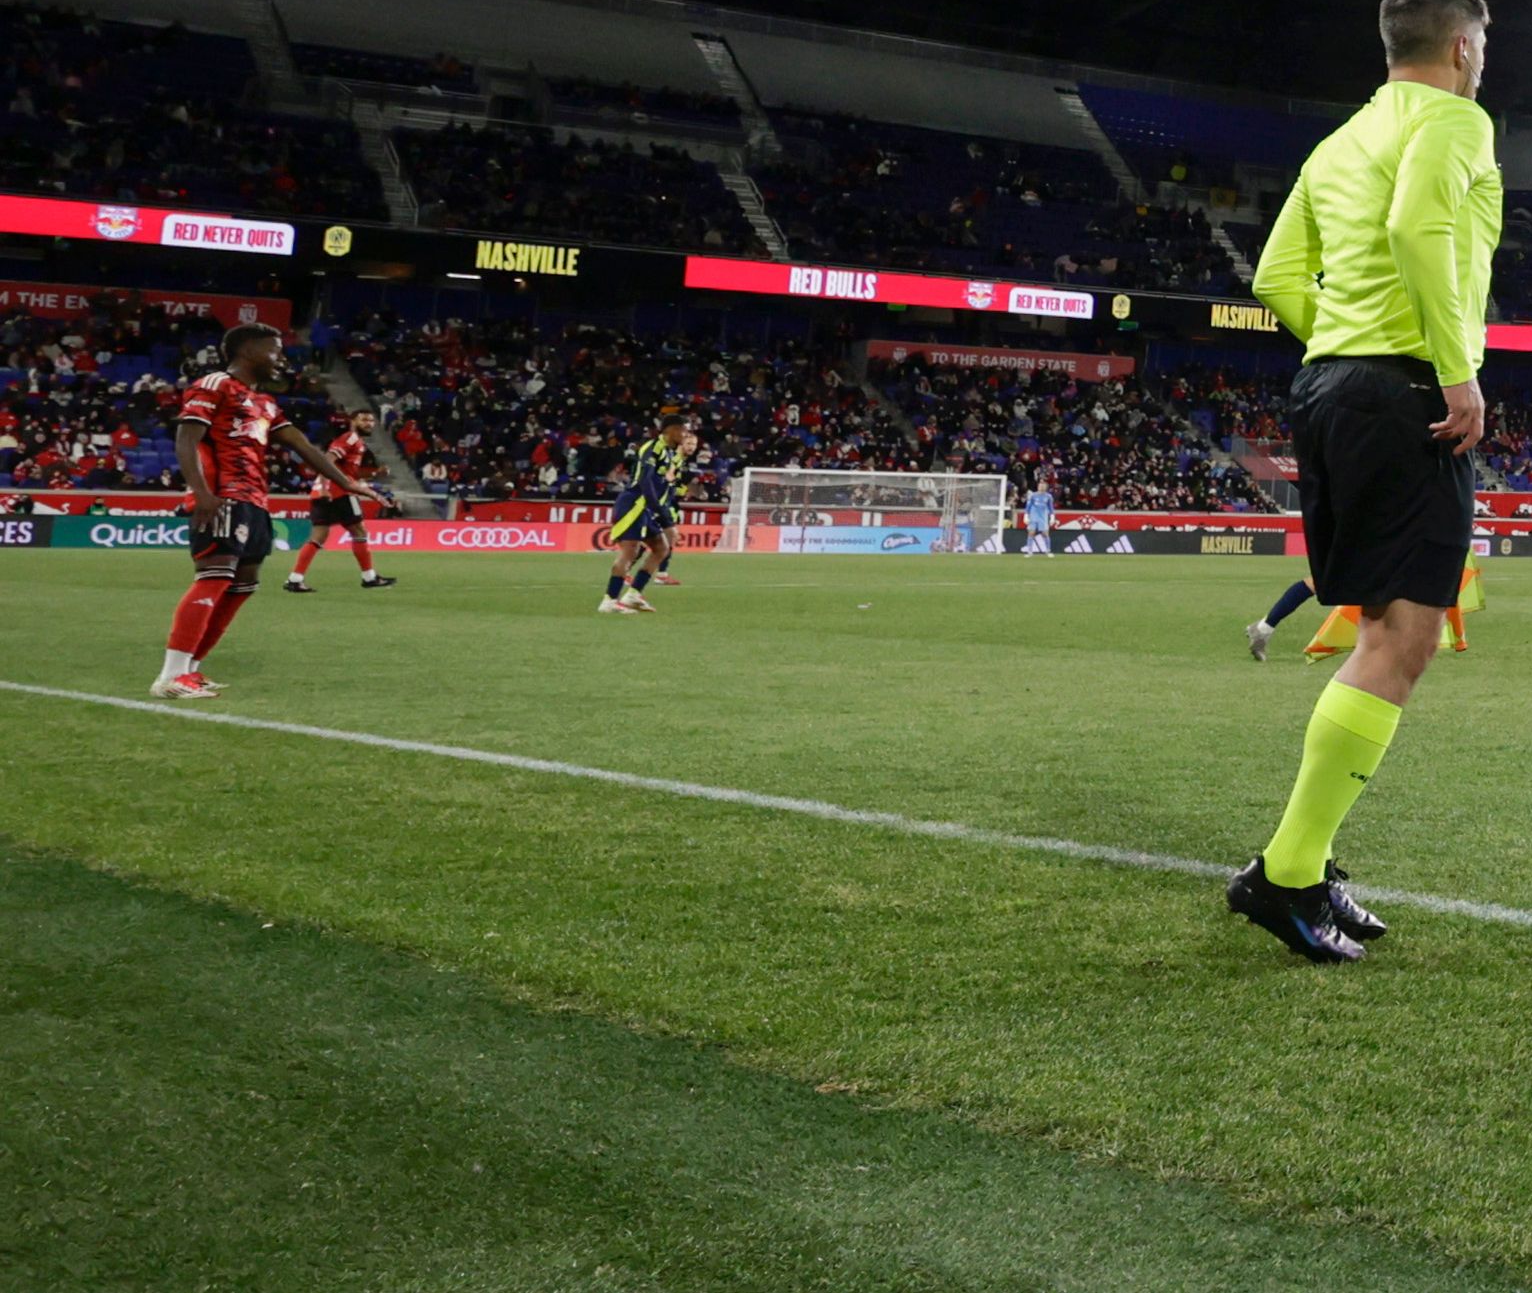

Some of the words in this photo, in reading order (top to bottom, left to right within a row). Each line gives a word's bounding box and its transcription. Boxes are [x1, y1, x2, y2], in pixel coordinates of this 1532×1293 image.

[174, 222, 197, 241] RED
[203, 225, 242, 245] NEVER
[249, 229, 284, 248] QUITS
[475, 240, 580, 276] NASHVILLE
[788, 267, 823, 296] RED
[824, 270, 877, 300] BULLS
[17, 291, 58, 308] THE
[162, 301, 211, 317] TATE
[1016, 294, 1033, 310] RED
[1035, 296, 1061, 311] NEVER
[1063, 298, 1088, 314] QUITS
[1211, 303, 1278, 332] NASHVILLE
[931, 352, 949, 364] TO
[952, 353, 978, 366] THE
[981, 355, 1035, 370] GARDEN
[1037, 359, 1077, 373] STATE
[90, 523, 190, 547] QuickC
[338, 527, 413, 546] Audi
[1201, 536, 1253, 554] NASHVILLE
